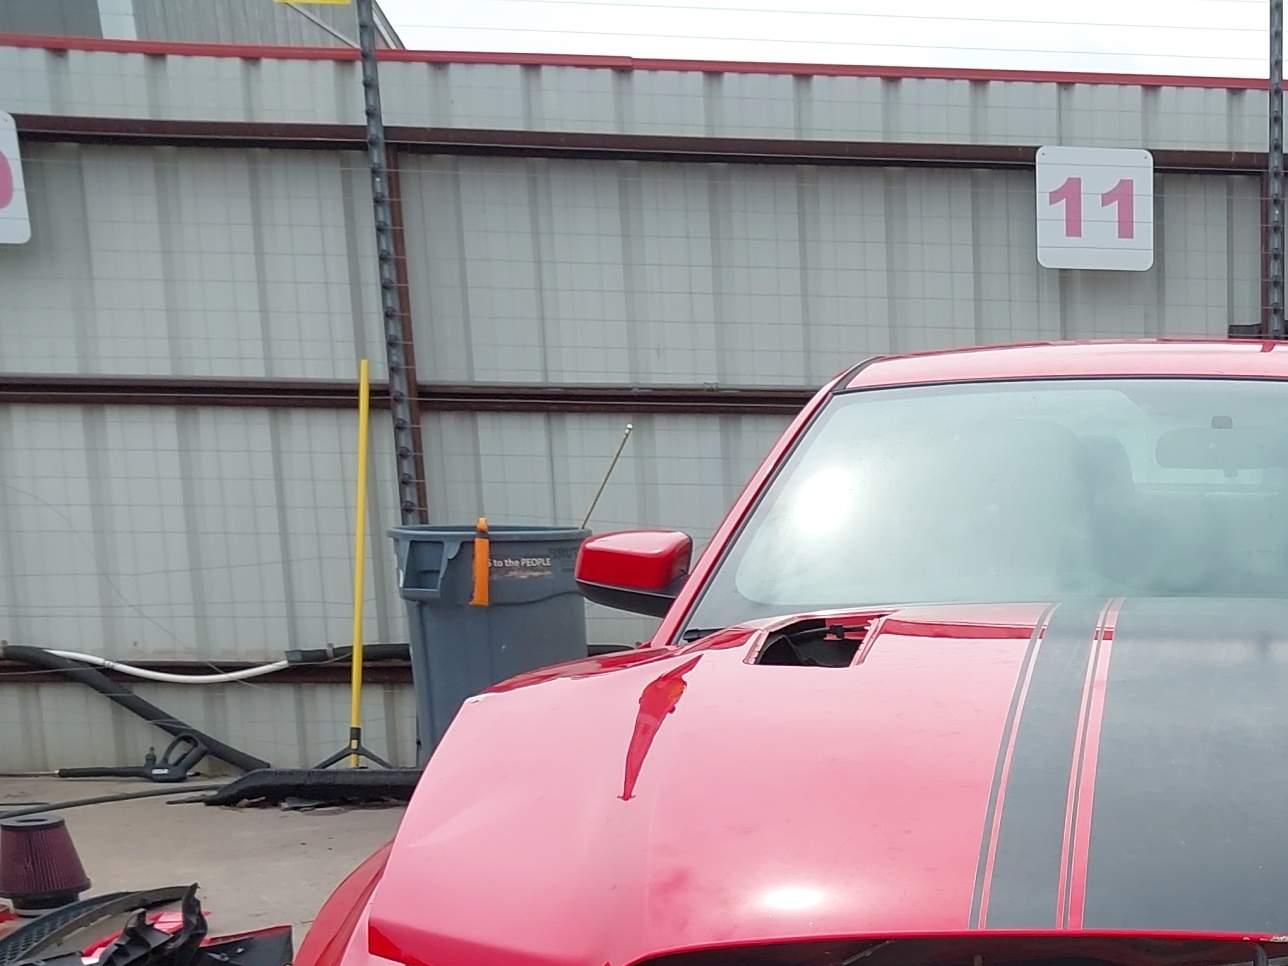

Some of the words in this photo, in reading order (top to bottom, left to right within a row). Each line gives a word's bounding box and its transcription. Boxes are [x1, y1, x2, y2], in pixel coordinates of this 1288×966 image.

[1048, 176, 1134, 240] 11
[493, 559, 504, 568] to
[505, 557, 520, 568] the
[520, 556, 552, 568] PEOPLE
